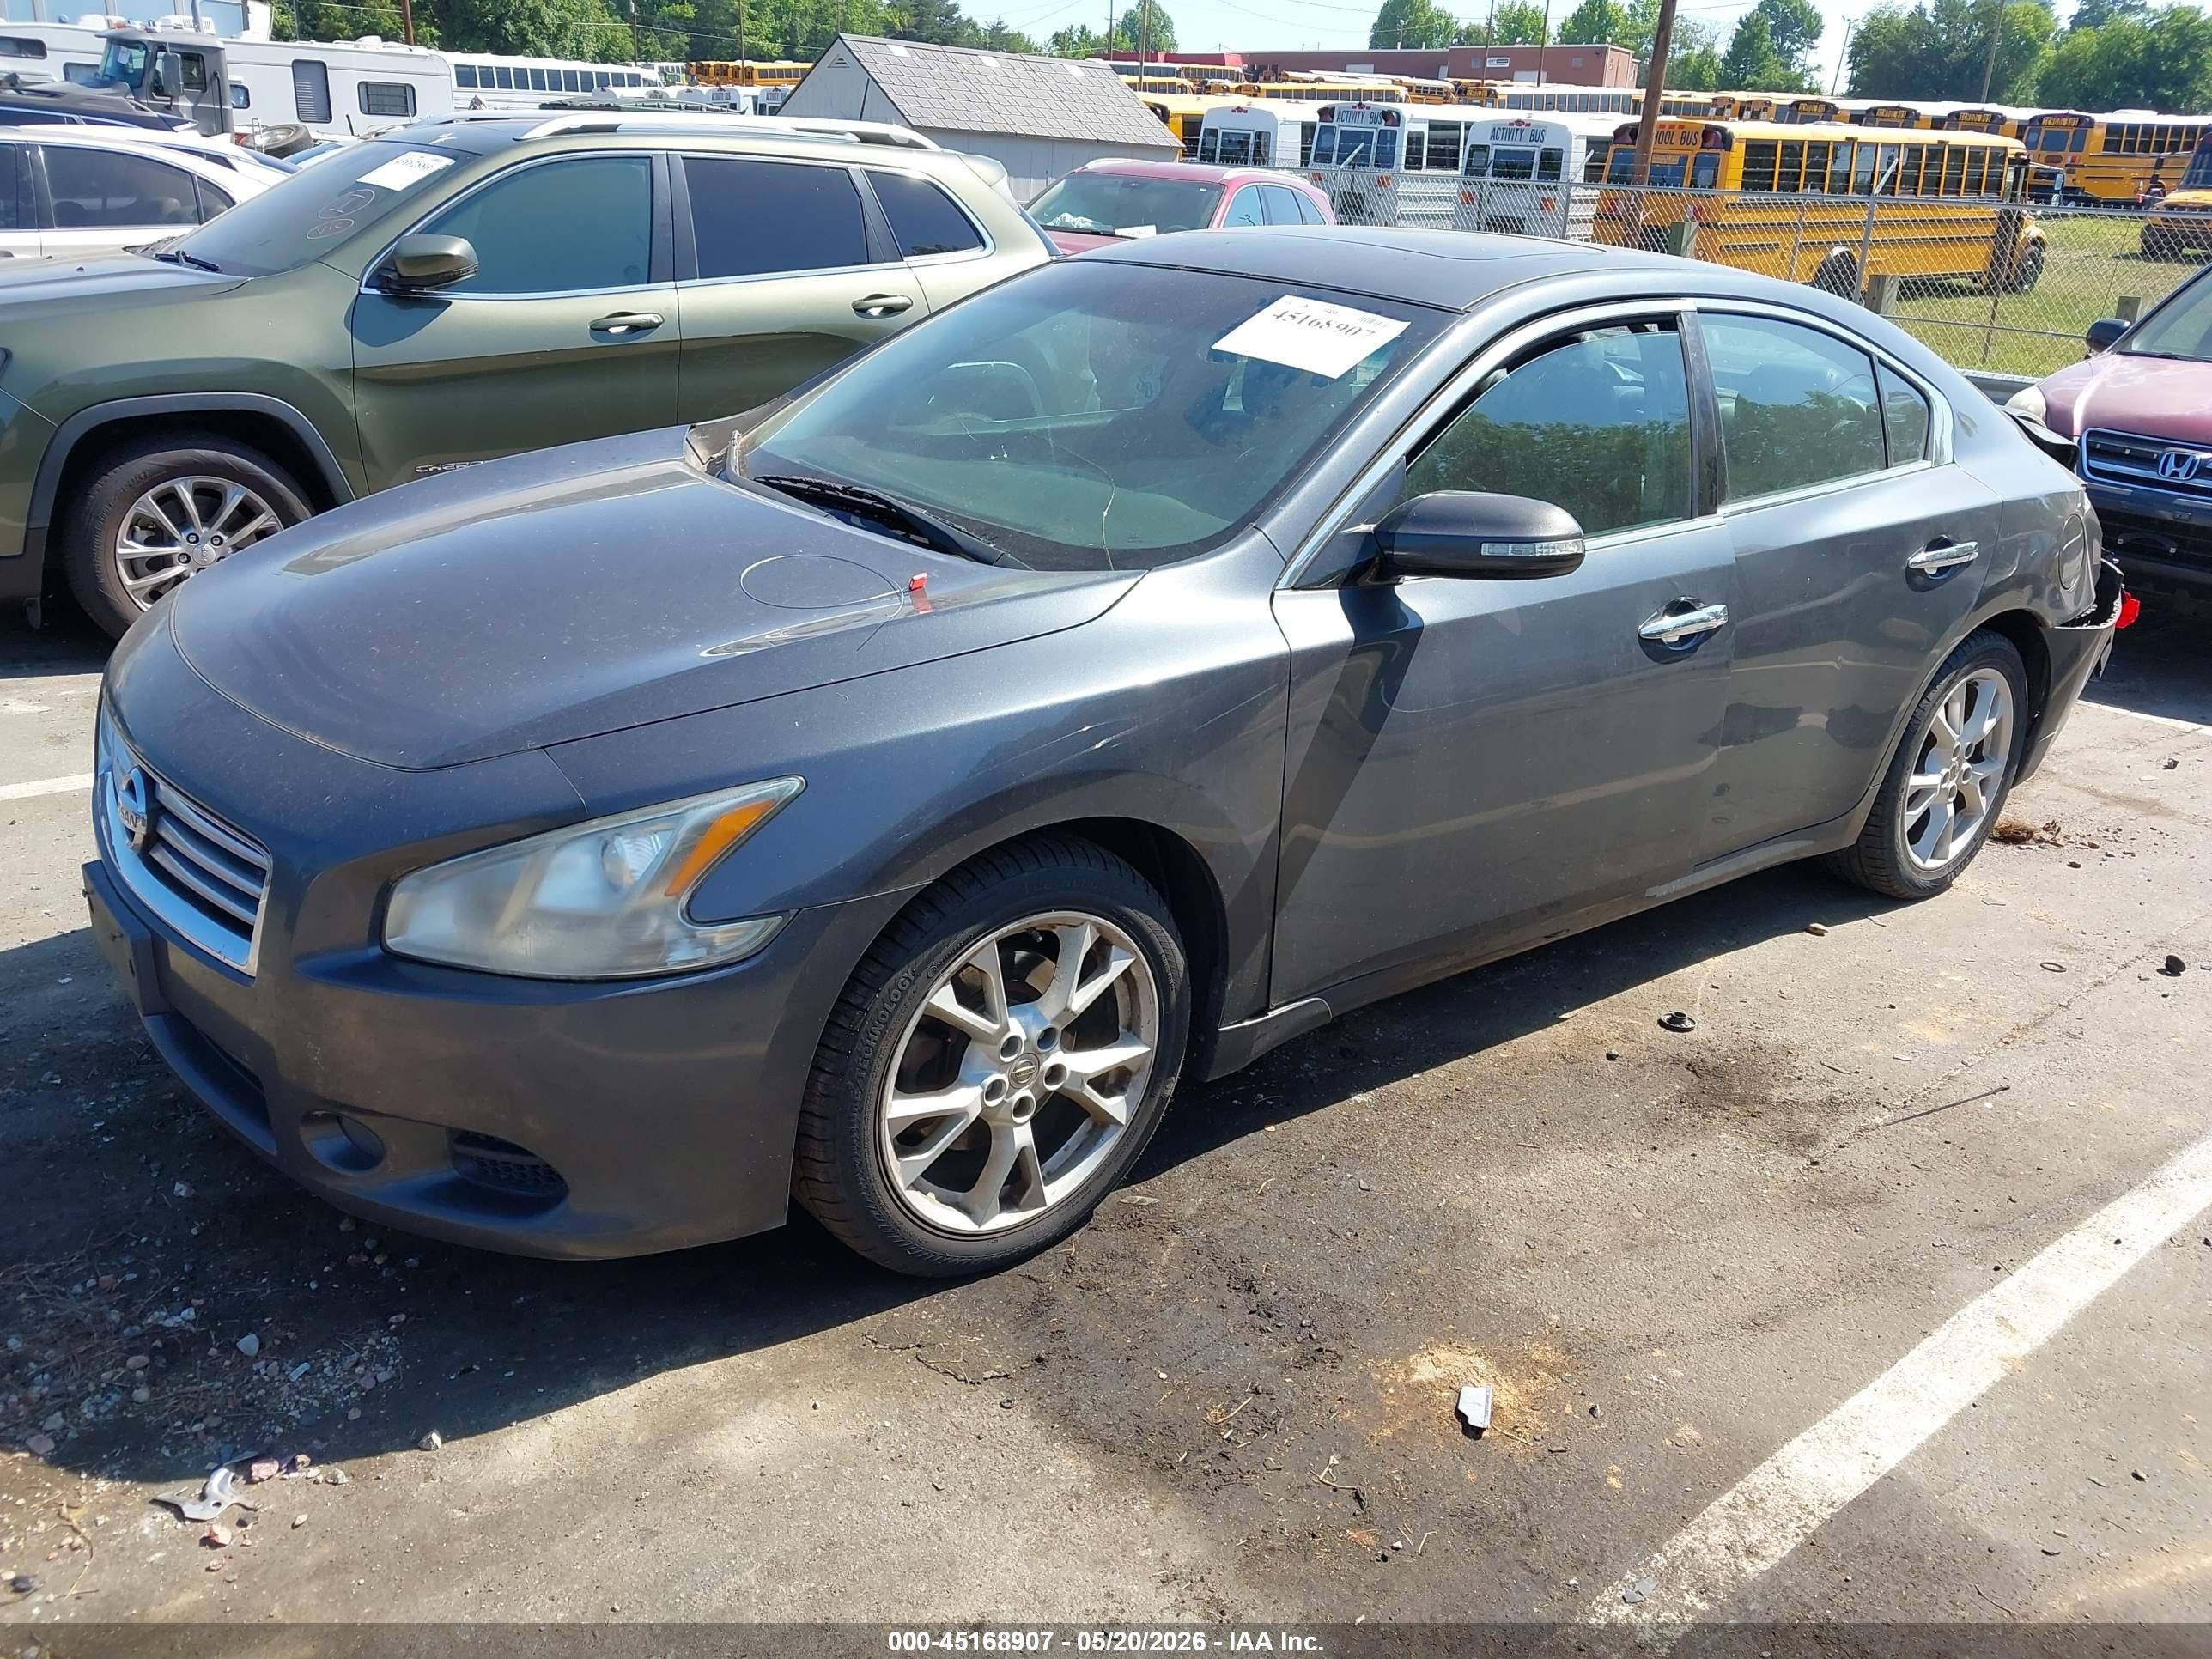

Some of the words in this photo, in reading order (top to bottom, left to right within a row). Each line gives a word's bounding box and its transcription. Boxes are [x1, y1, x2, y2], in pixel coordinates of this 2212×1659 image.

[1336, 110, 1365, 124] ACTIVITY
[1370, 111, 1382, 125] BUS
[1490, 127, 1524, 142] ACTIVITY
[1529, 128, 1546, 143] BUS
[1655, 130, 1674, 145] HOOL
[1679, 131, 1699, 146] BUS
[1273, 309, 1376, 337] 45168907
